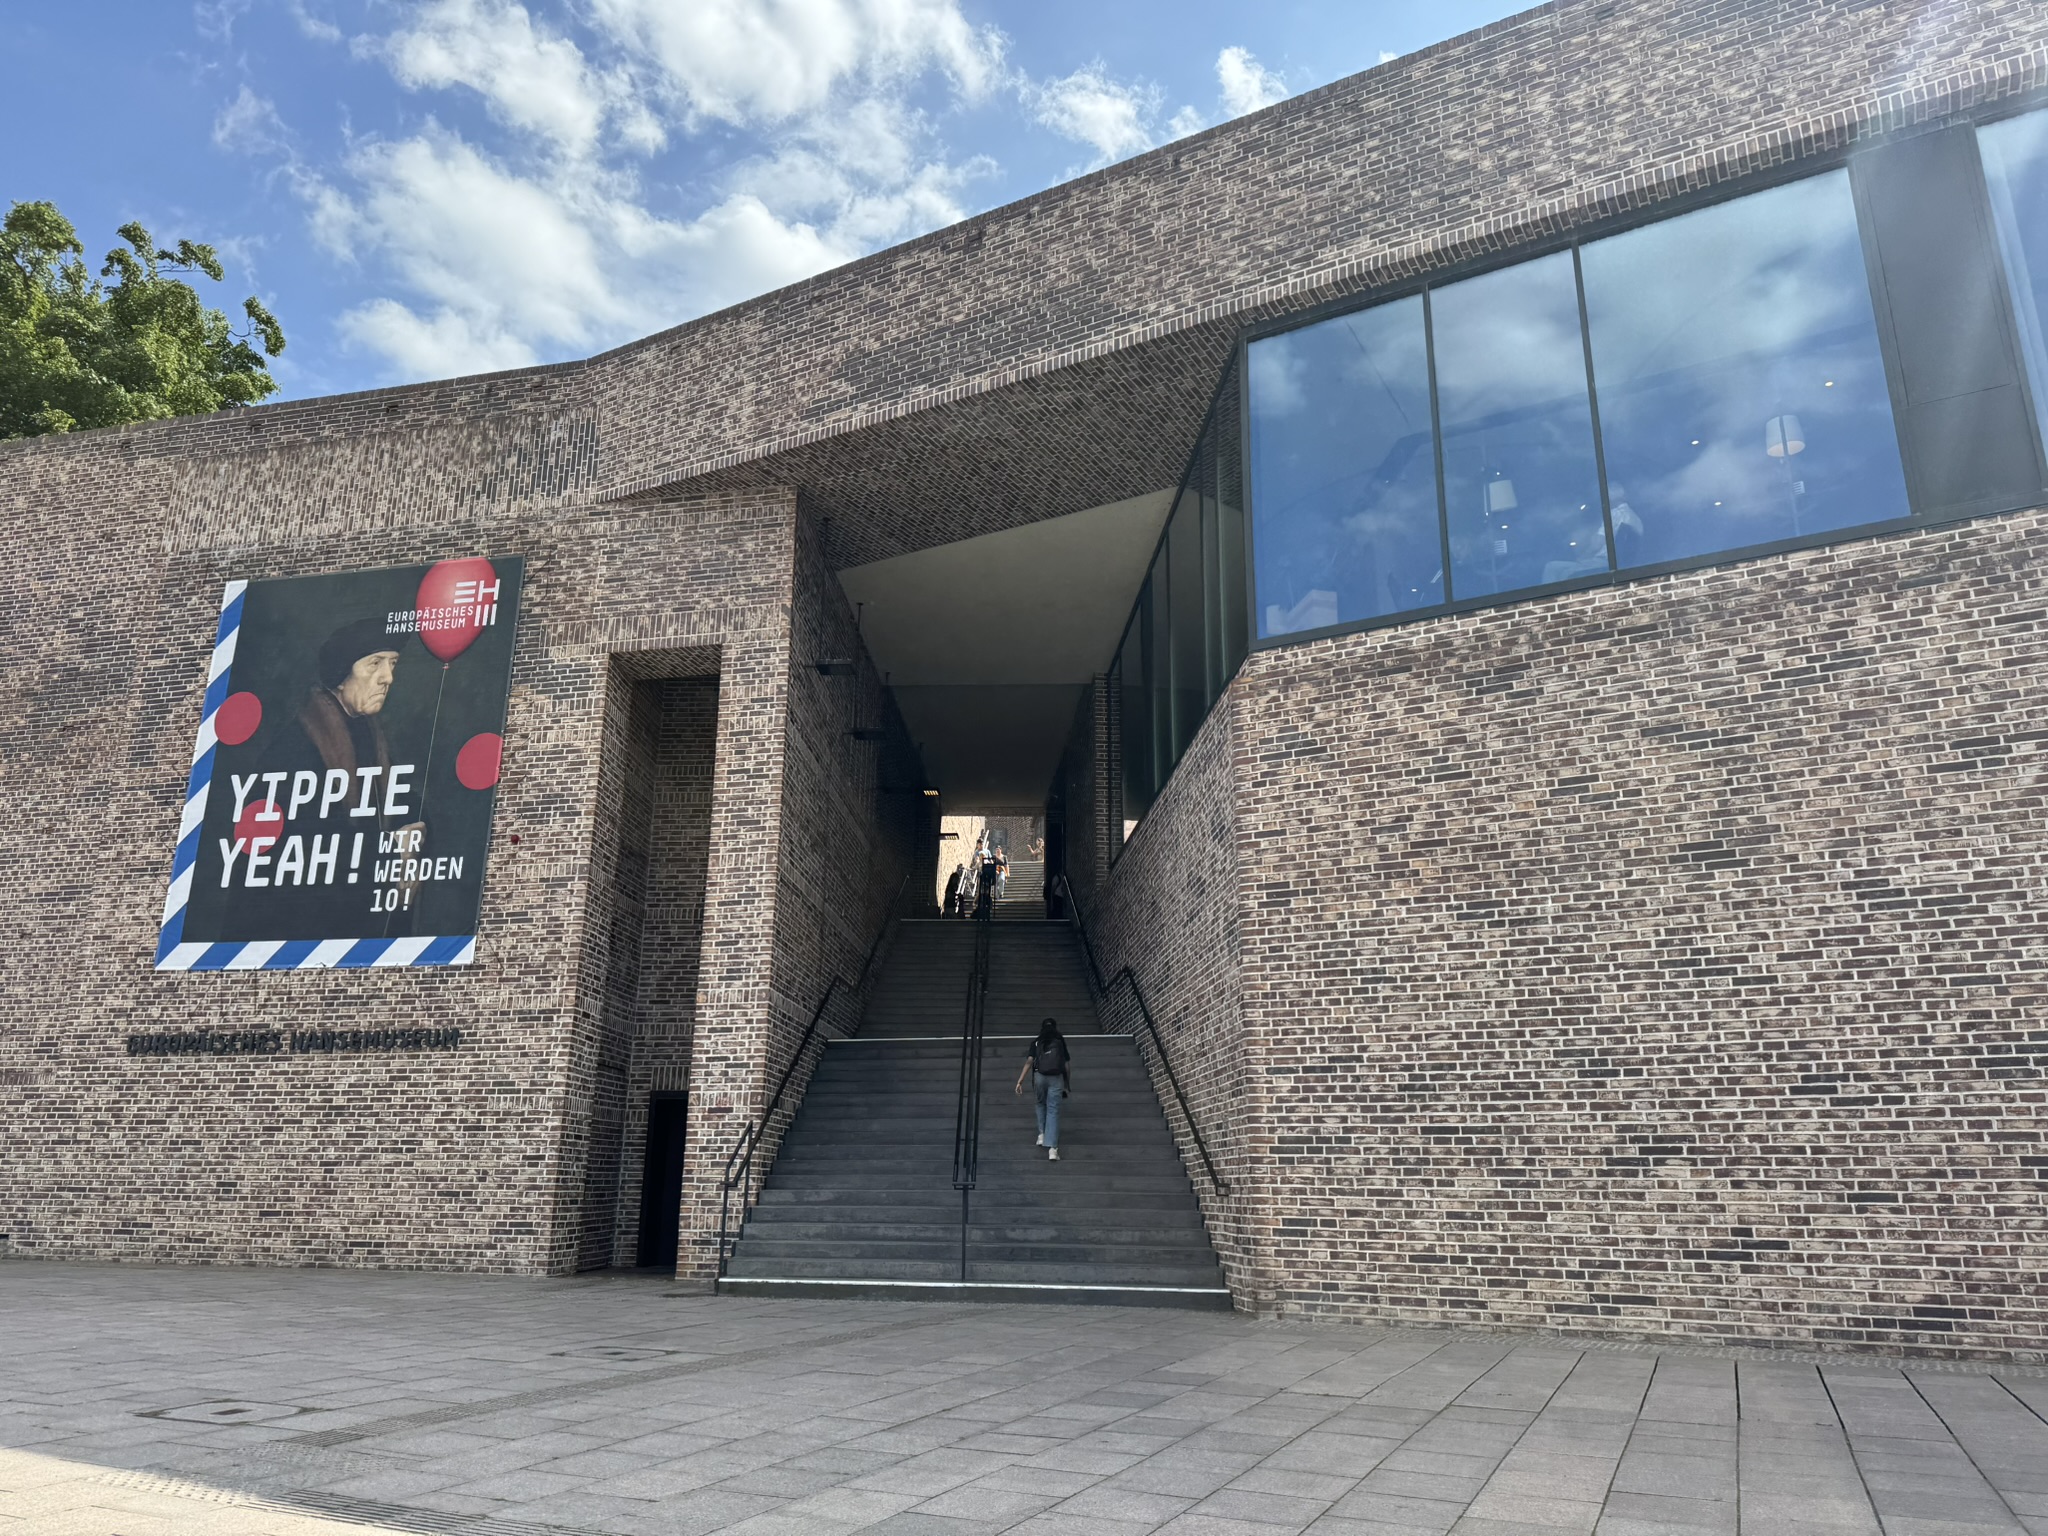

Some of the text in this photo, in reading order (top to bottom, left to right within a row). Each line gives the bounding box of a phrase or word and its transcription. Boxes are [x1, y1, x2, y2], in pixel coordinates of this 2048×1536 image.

[386, 618, 465, 634] HANSEMUSEUM
[388, 606, 474, 623] EUROPÄISCHES
[231, 764, 415, 823] YIPPIE
[378, 830, 422, 854] WIR
[219, 832, 364, 888] YEAH!
[374, 856, 463, 883] WERDEN
[370, 888, 411, 913] 10!
[289, 1027, 460, 1052] HANSEMUSEUM
